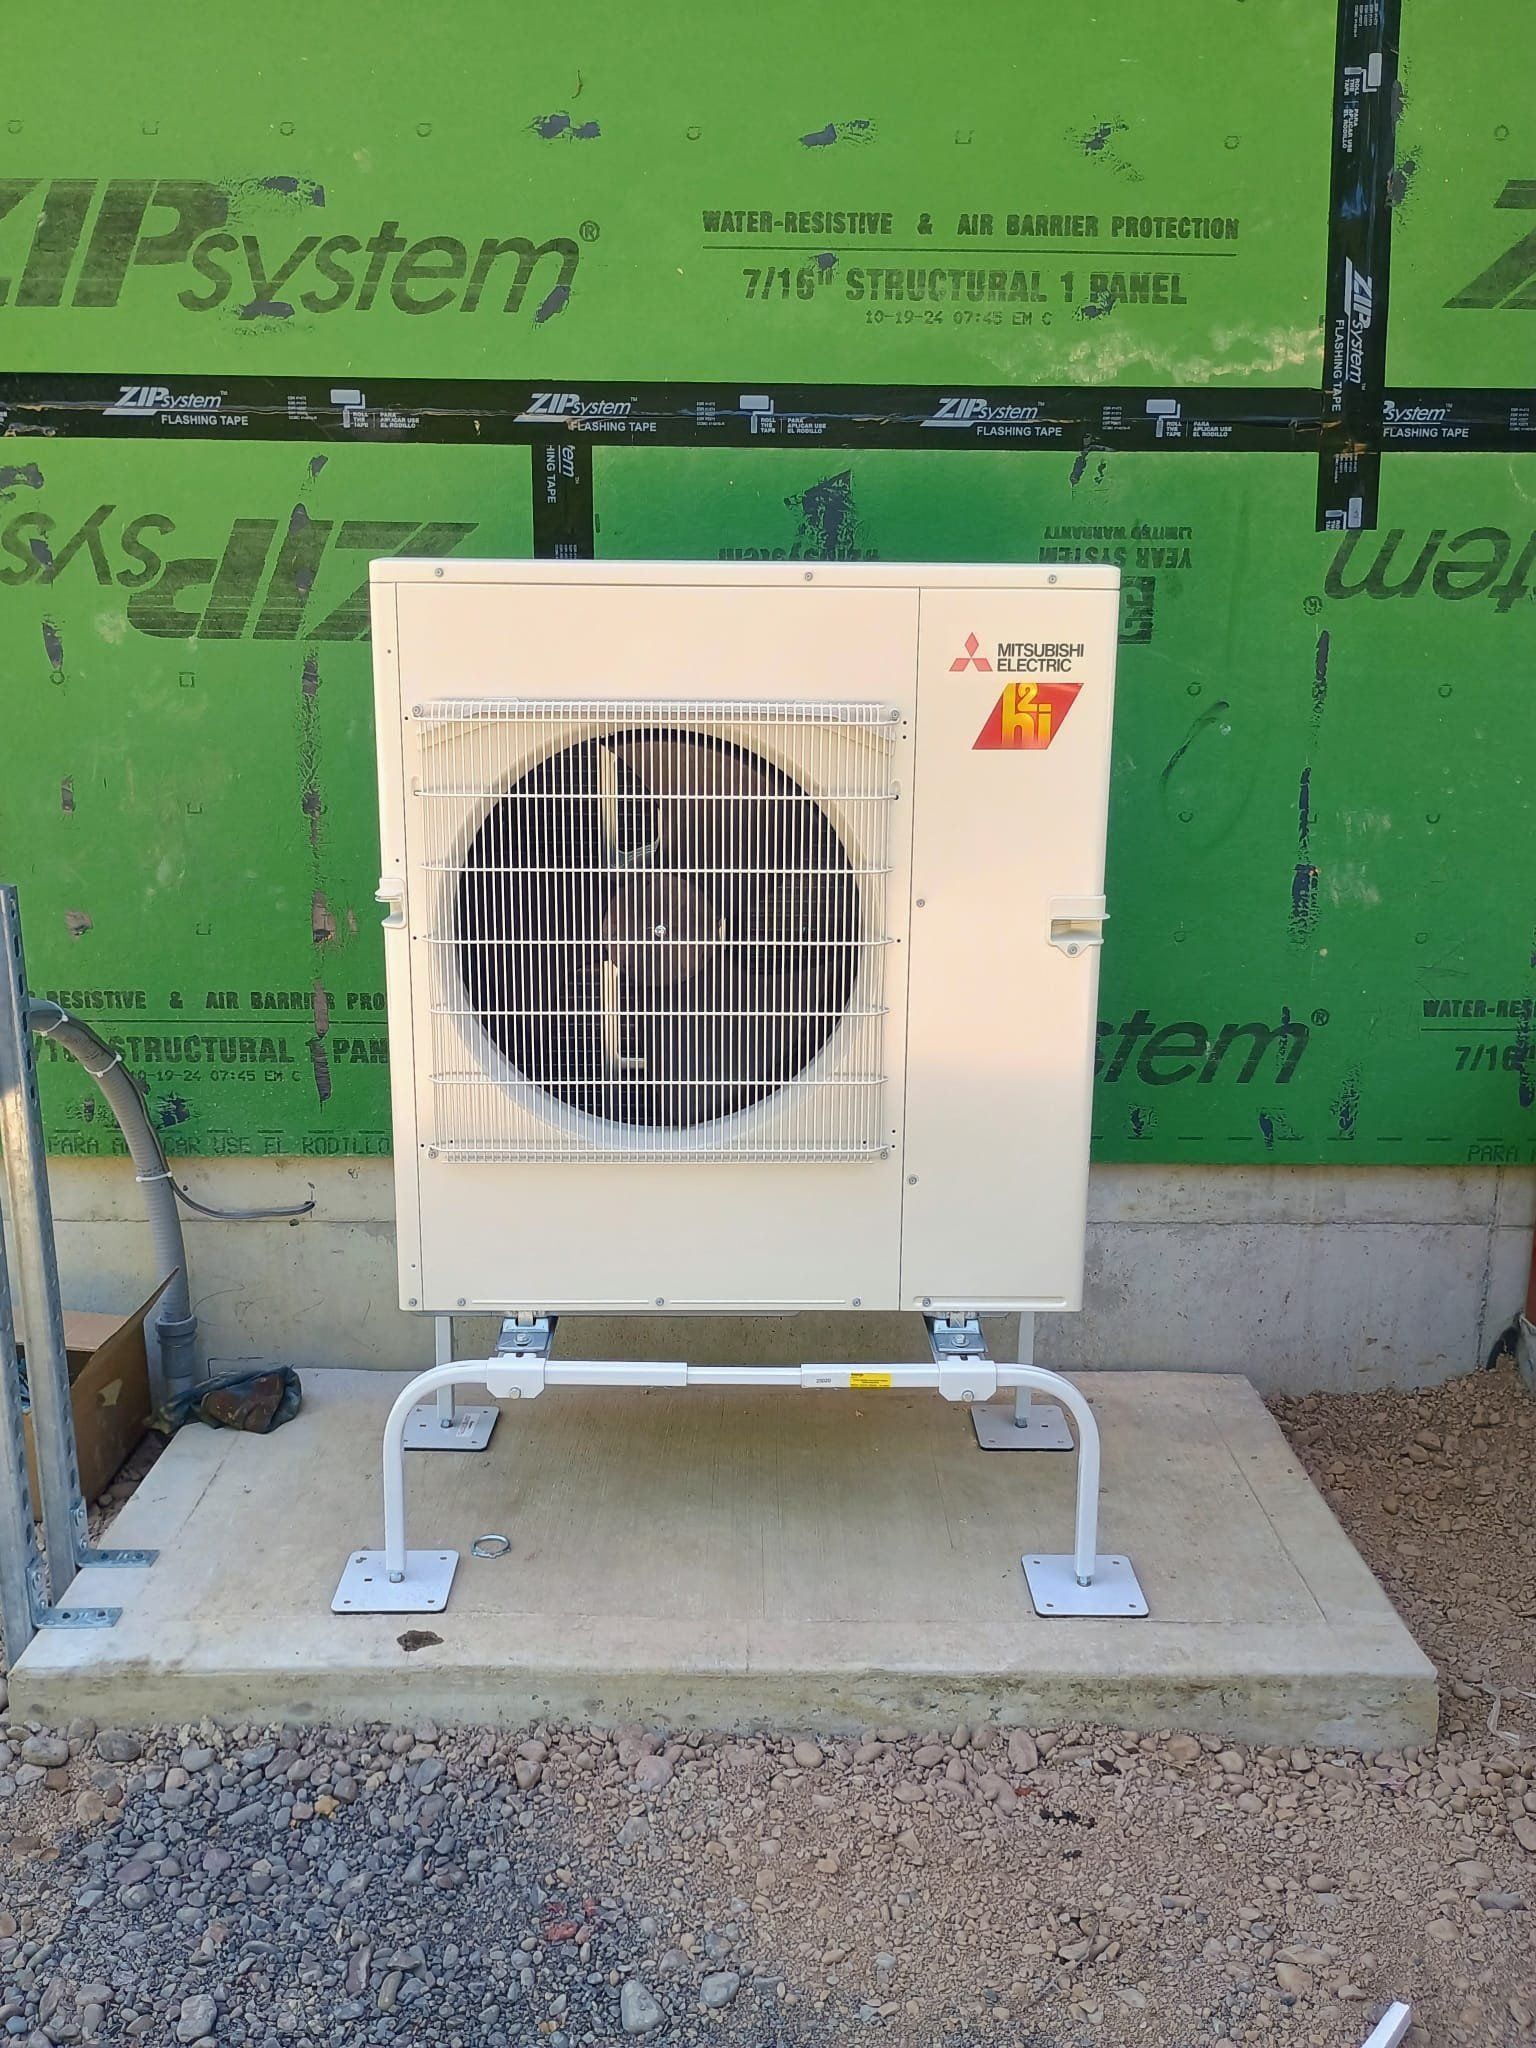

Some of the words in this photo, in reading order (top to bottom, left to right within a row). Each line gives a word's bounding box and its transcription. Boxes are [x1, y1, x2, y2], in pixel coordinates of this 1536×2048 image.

[702, 210, 893, 235] WATER-RESISTIVE
[916, 212, 933, 235] &
[957, 213, 993, 236] AIR
[1006, 213, 1098, 237] BARRIER
[1111, 215, 1239, 240] PROTECTION
[846, 268, 1047, 303] STRUCTURAL
[1059, 270, 1074, 303] 1
[1089, 271, 1188, 305] PANEL
[1332, 319, 1345, 379] FLASHING
[1331, 382, 1343, 412] TAPE
[161, 414, 218, 425] FLASHING
[221, 415, 249, 426] TAPE
[570, 421, 630, 432] FLASHING
[632, 422, 657, 432] TAPE
[976, 426, 1032, 437] FLASHING
[1035, 427, 1063, 437] TAPE
[1383, 428, 1439, 439] FLASHING
[1441, 428, 1470, 439] TAPE
[546, 475, 557, 504] TAPE
[1136, 547, 1193, 569] YEAR
[997, 643, 1084, 658] MITSUBISHI
[997, 658, 1072, 673] ELECTRIC
[29, 990, 147, 1009] RESISTIVE
[169, 991, 184, 1009] &
[205, 992, 240, 1010] AIR
[250, 992, 335, 1010] BARRIR
[210, 1070, 256, 1082] 07:45
[213, 1136, 251, 1155] USE
[1467, 1144, 1518, 1162] PARA
